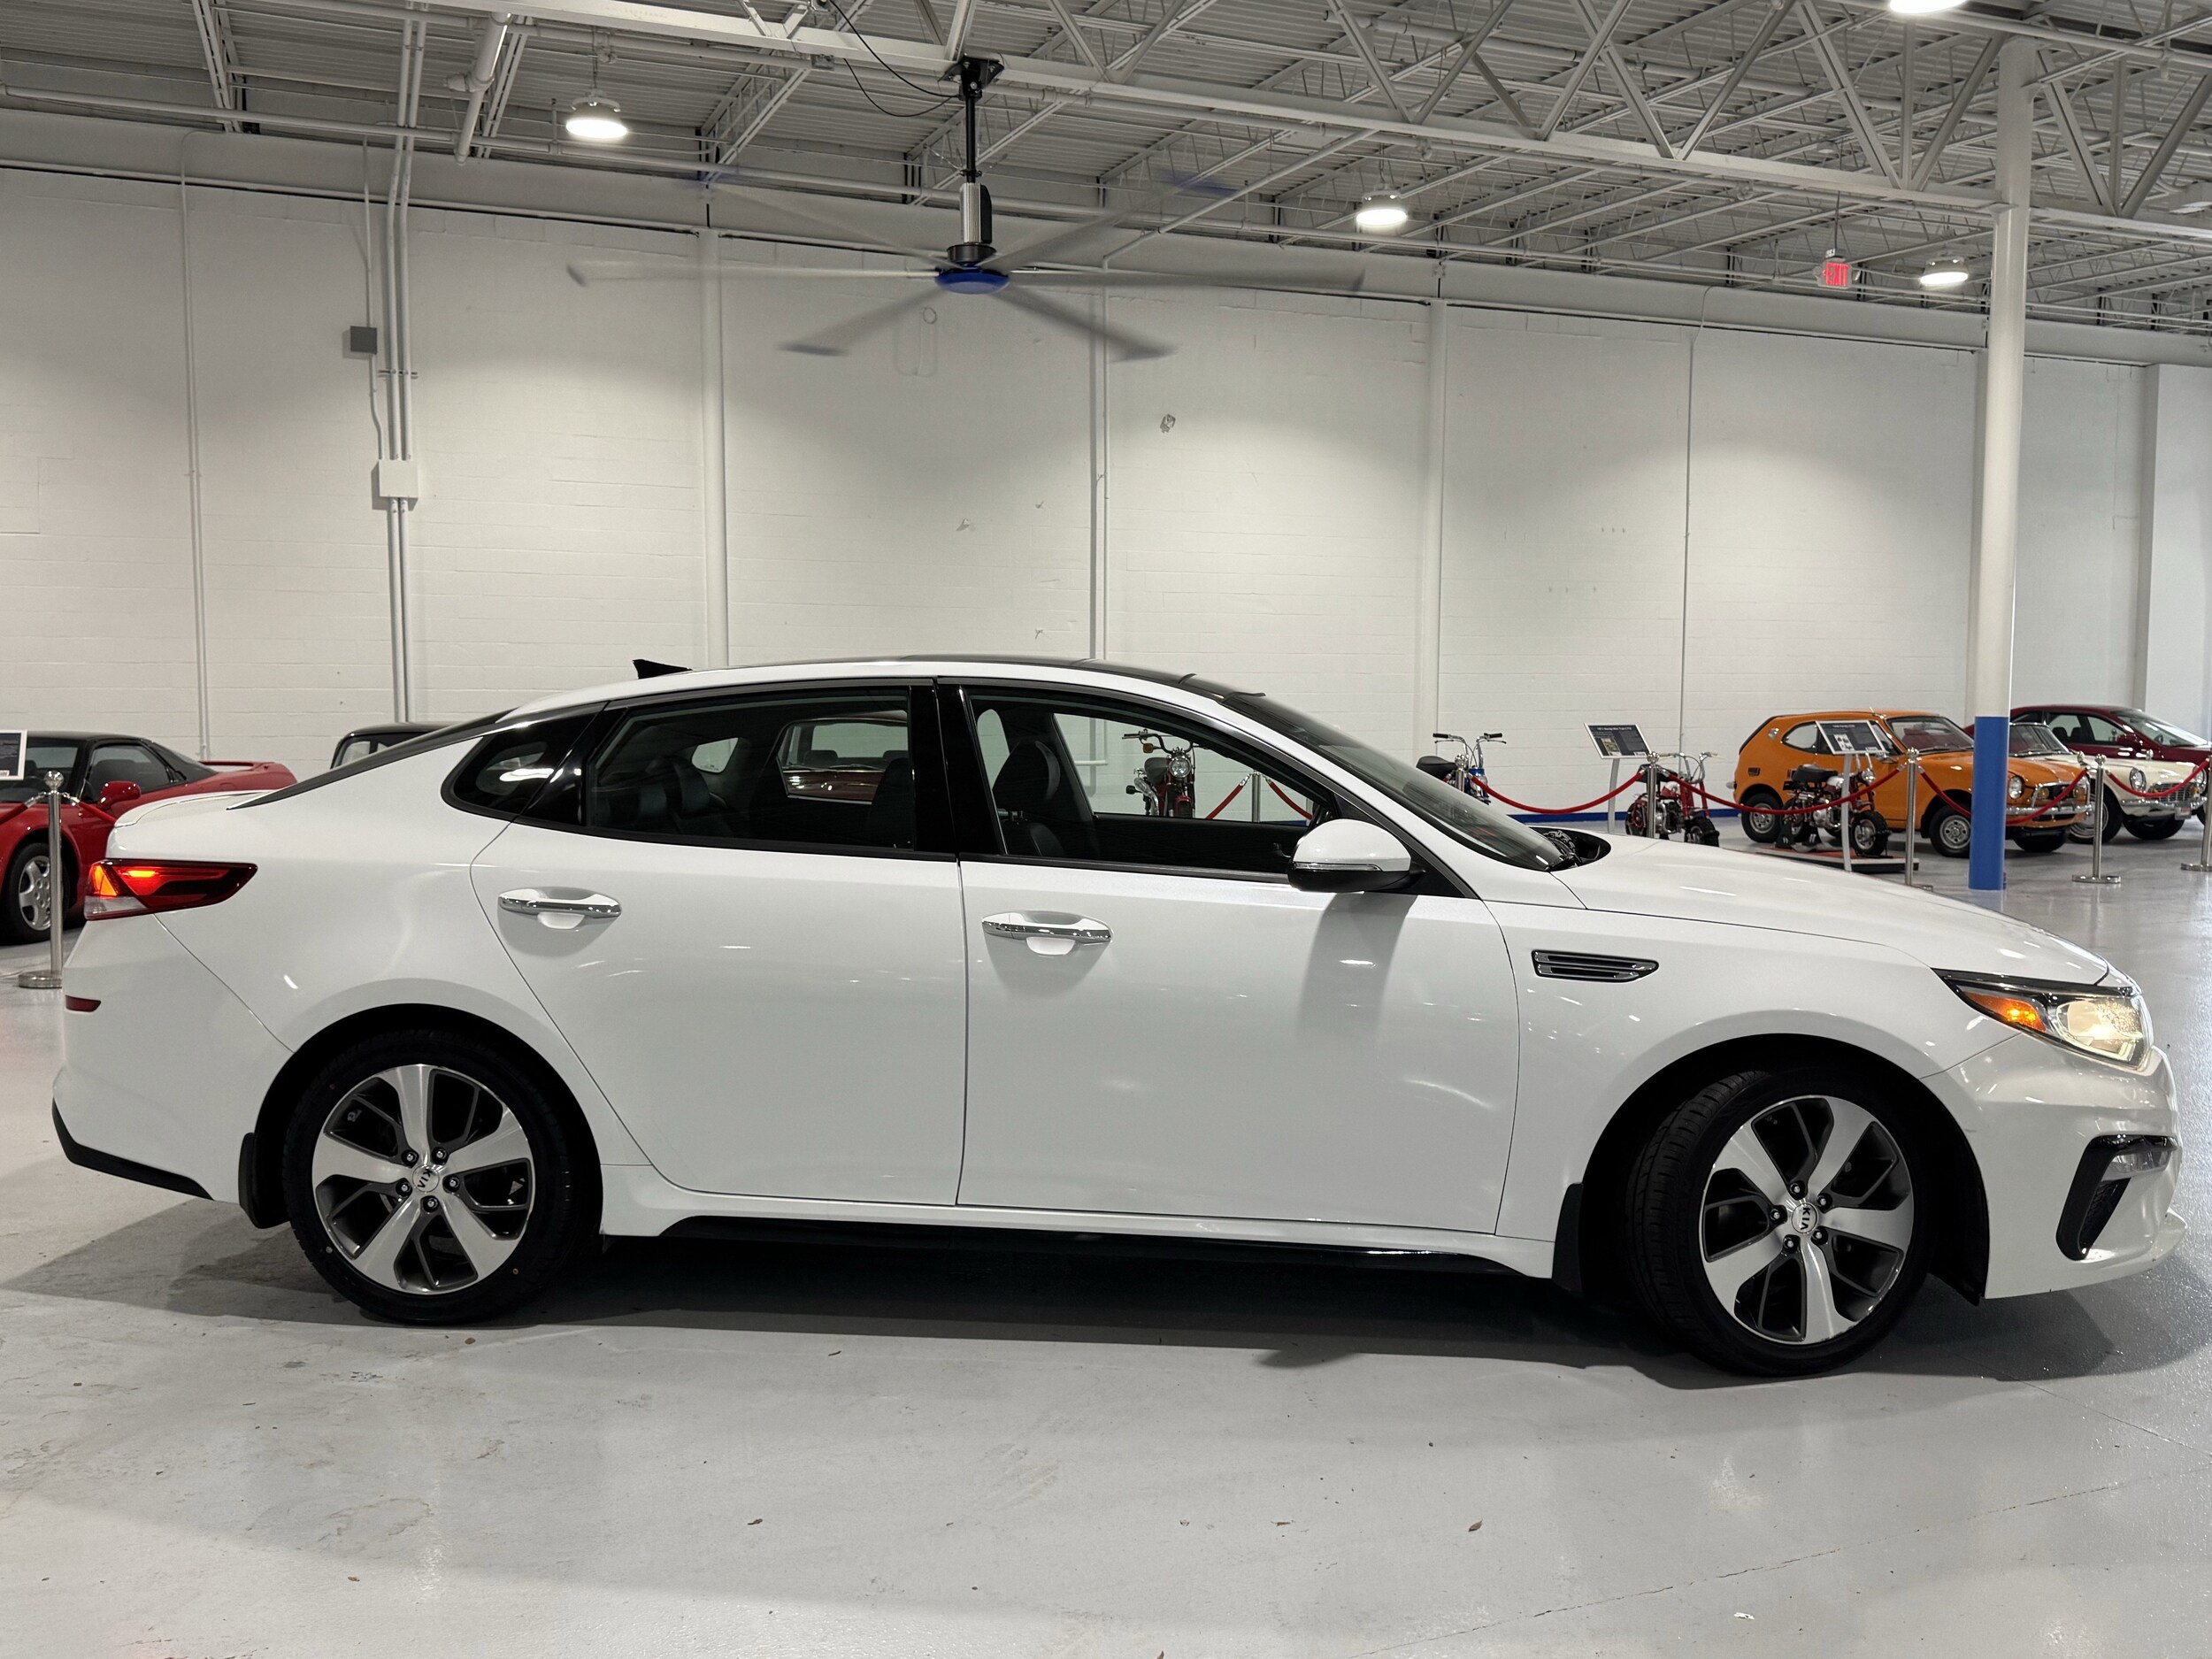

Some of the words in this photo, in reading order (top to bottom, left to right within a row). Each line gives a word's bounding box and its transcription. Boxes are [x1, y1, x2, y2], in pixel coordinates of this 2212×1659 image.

[1826, 262, 1848, 287] EXIT
[417, 1168, 433, 1187] KIA
[1801, 1207, 1810, 1230] KIA
